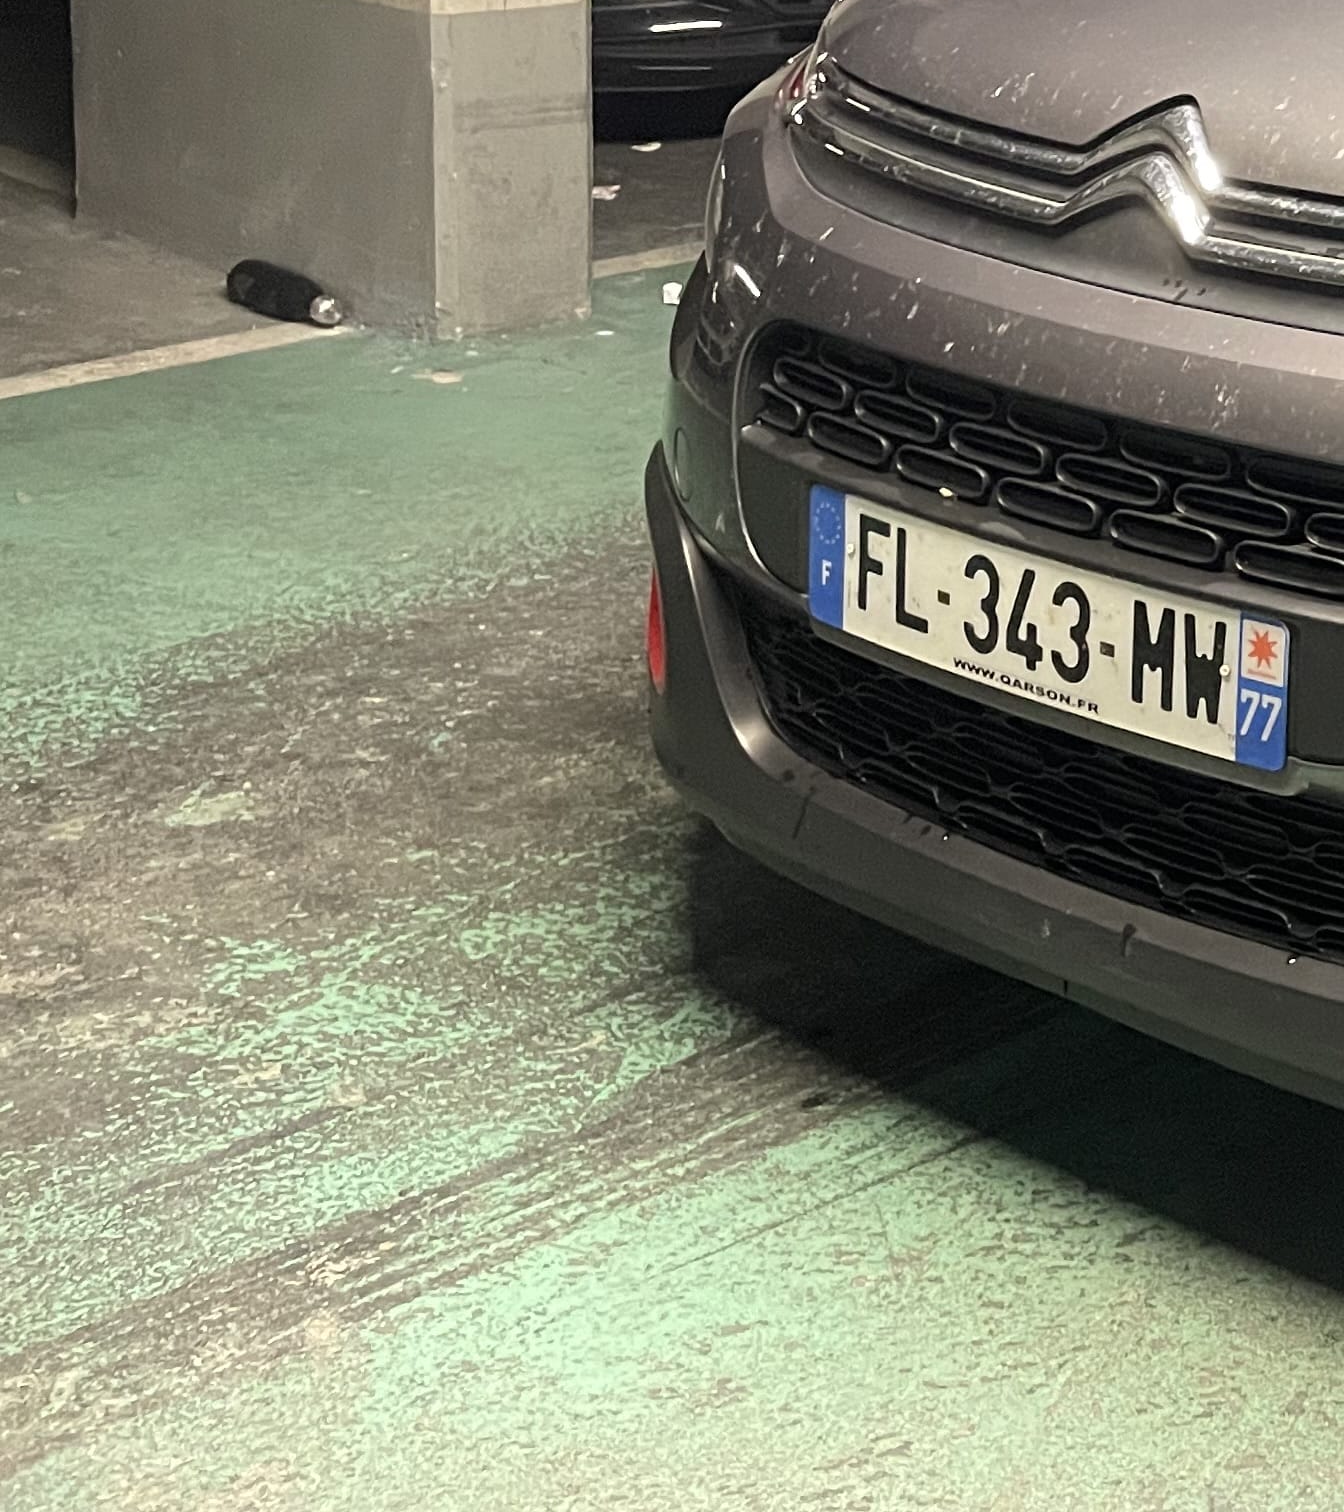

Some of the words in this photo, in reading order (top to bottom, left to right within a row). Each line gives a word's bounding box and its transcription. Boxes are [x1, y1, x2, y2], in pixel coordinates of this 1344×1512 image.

[822, 559, 833, 586] F
[857, 513, 1227, 724] FL-343-MW
[1240, 688, 1283, 742] 77
